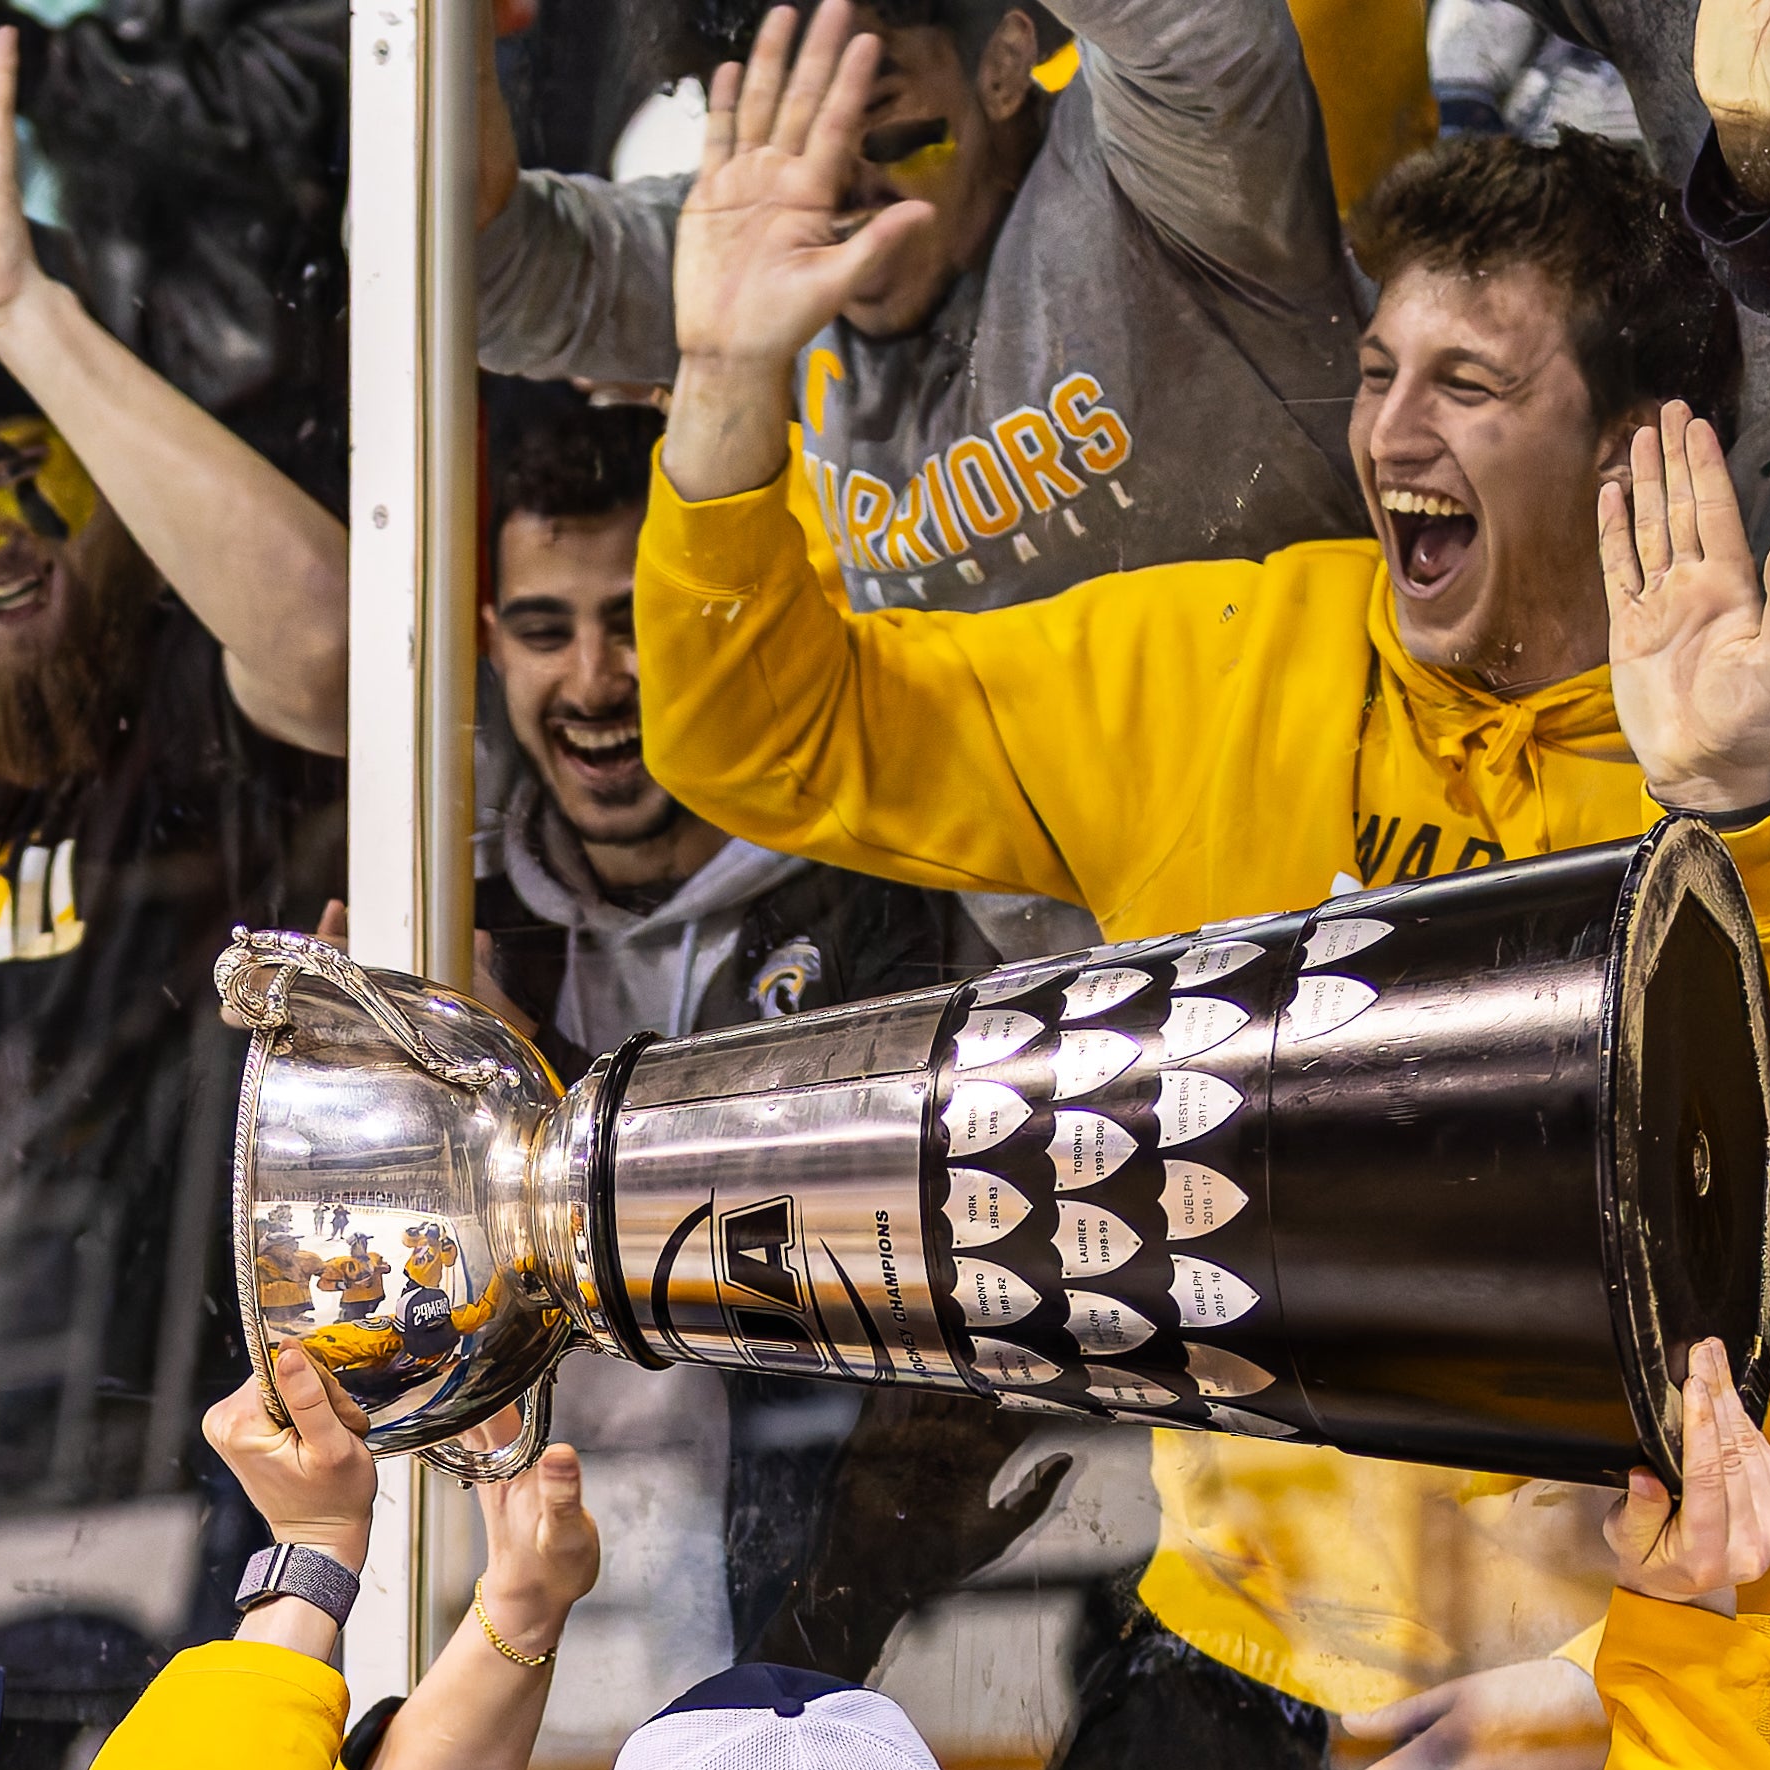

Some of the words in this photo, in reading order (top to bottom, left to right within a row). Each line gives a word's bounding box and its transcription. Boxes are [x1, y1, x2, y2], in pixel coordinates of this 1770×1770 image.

[1178, 1077, 1190, 1135] WESTERN
[1073, 1124, 1083, 1175] TORONTO
[1094, 1119, 1105, 1177] 1999-2000
[968, 1193, 978, 1223] YORK
[988, 1186, 999, 1230] 1982-83
[1183, 1174, 1194, 1225] GUELPH
[1077, 1218, 1090, 1264] LAURIER
[1098, 1219, 1111, 1263] 1998-99
[874, 1208, 908, 1324] CHAMPIONS
[975, 1272, 991, 1316] TORONTO
[1193, 1270, 1207, 1316] GUELPH
